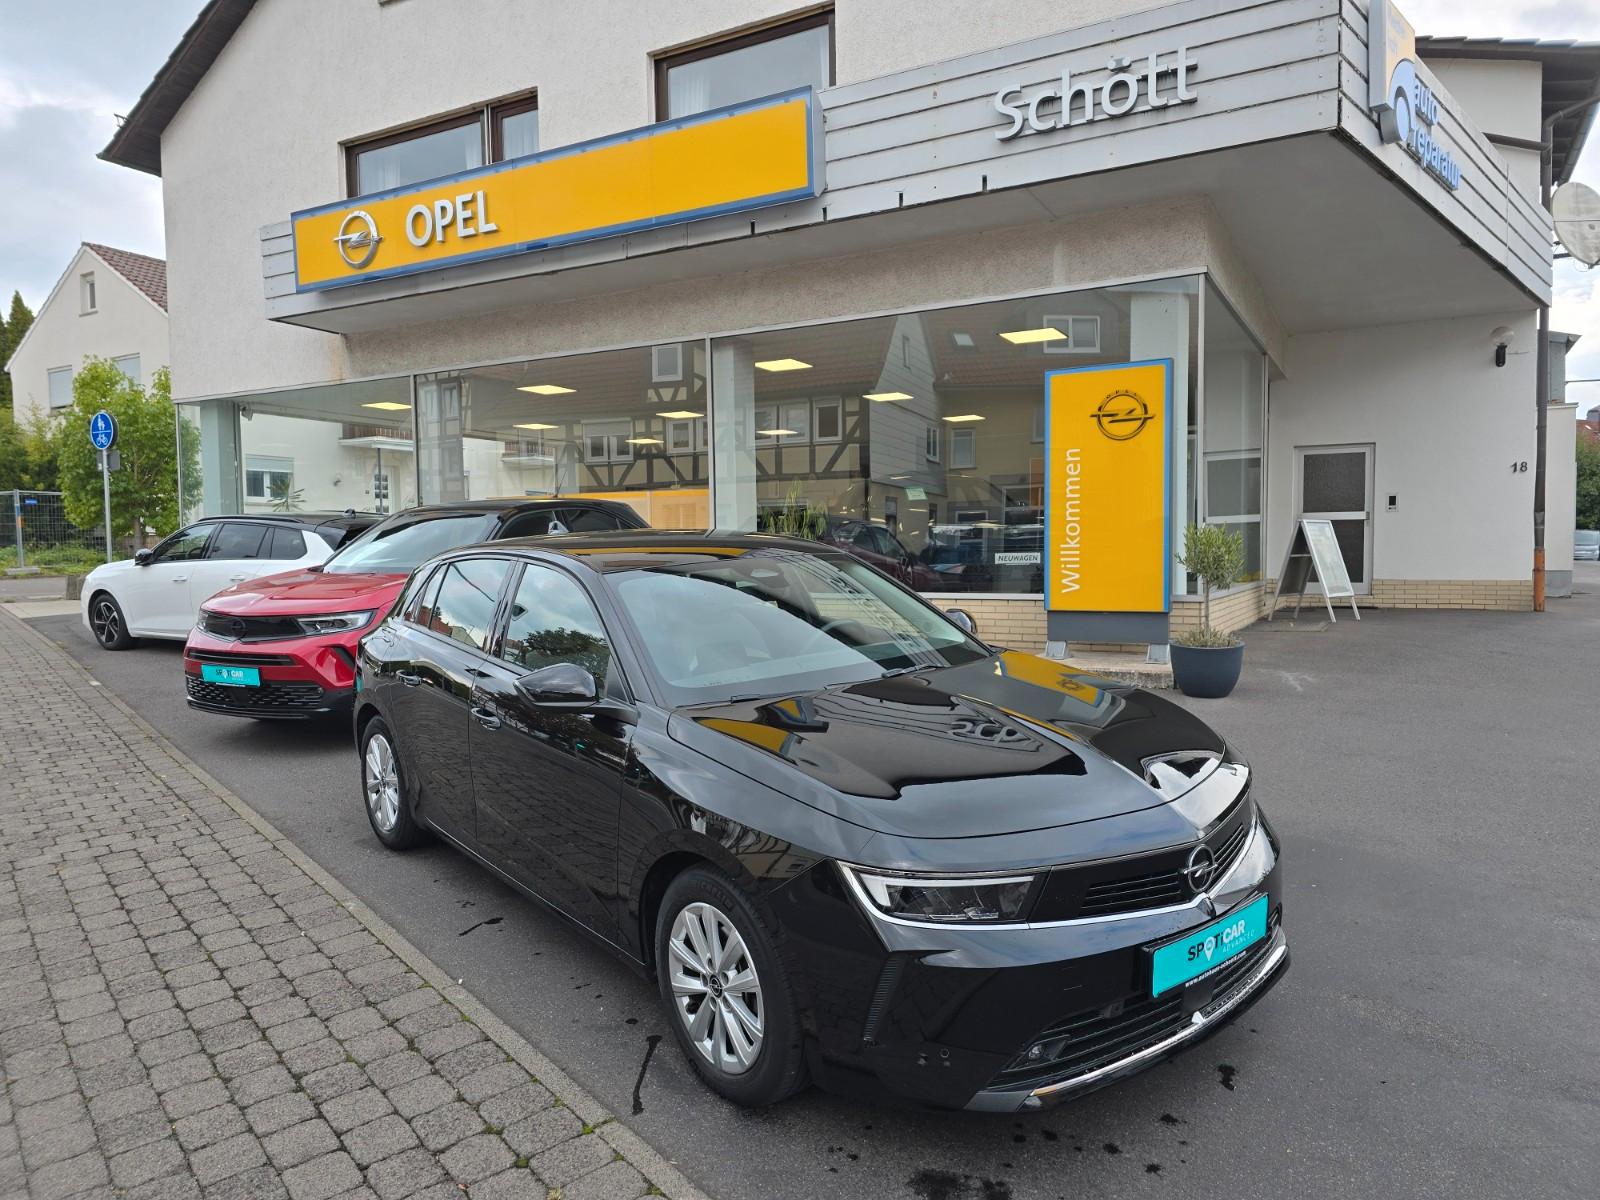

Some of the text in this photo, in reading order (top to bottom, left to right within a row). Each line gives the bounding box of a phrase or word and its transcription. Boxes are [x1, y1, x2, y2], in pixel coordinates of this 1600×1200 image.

[994, 47, 1198, 141] Schött
[1412, 127, 1462, 190] reparatur
[405, 190, 498, 247] OPEL
[1510, 461, 1528, 473] 18
[1060, 448, 1081, 593] Willkommen
